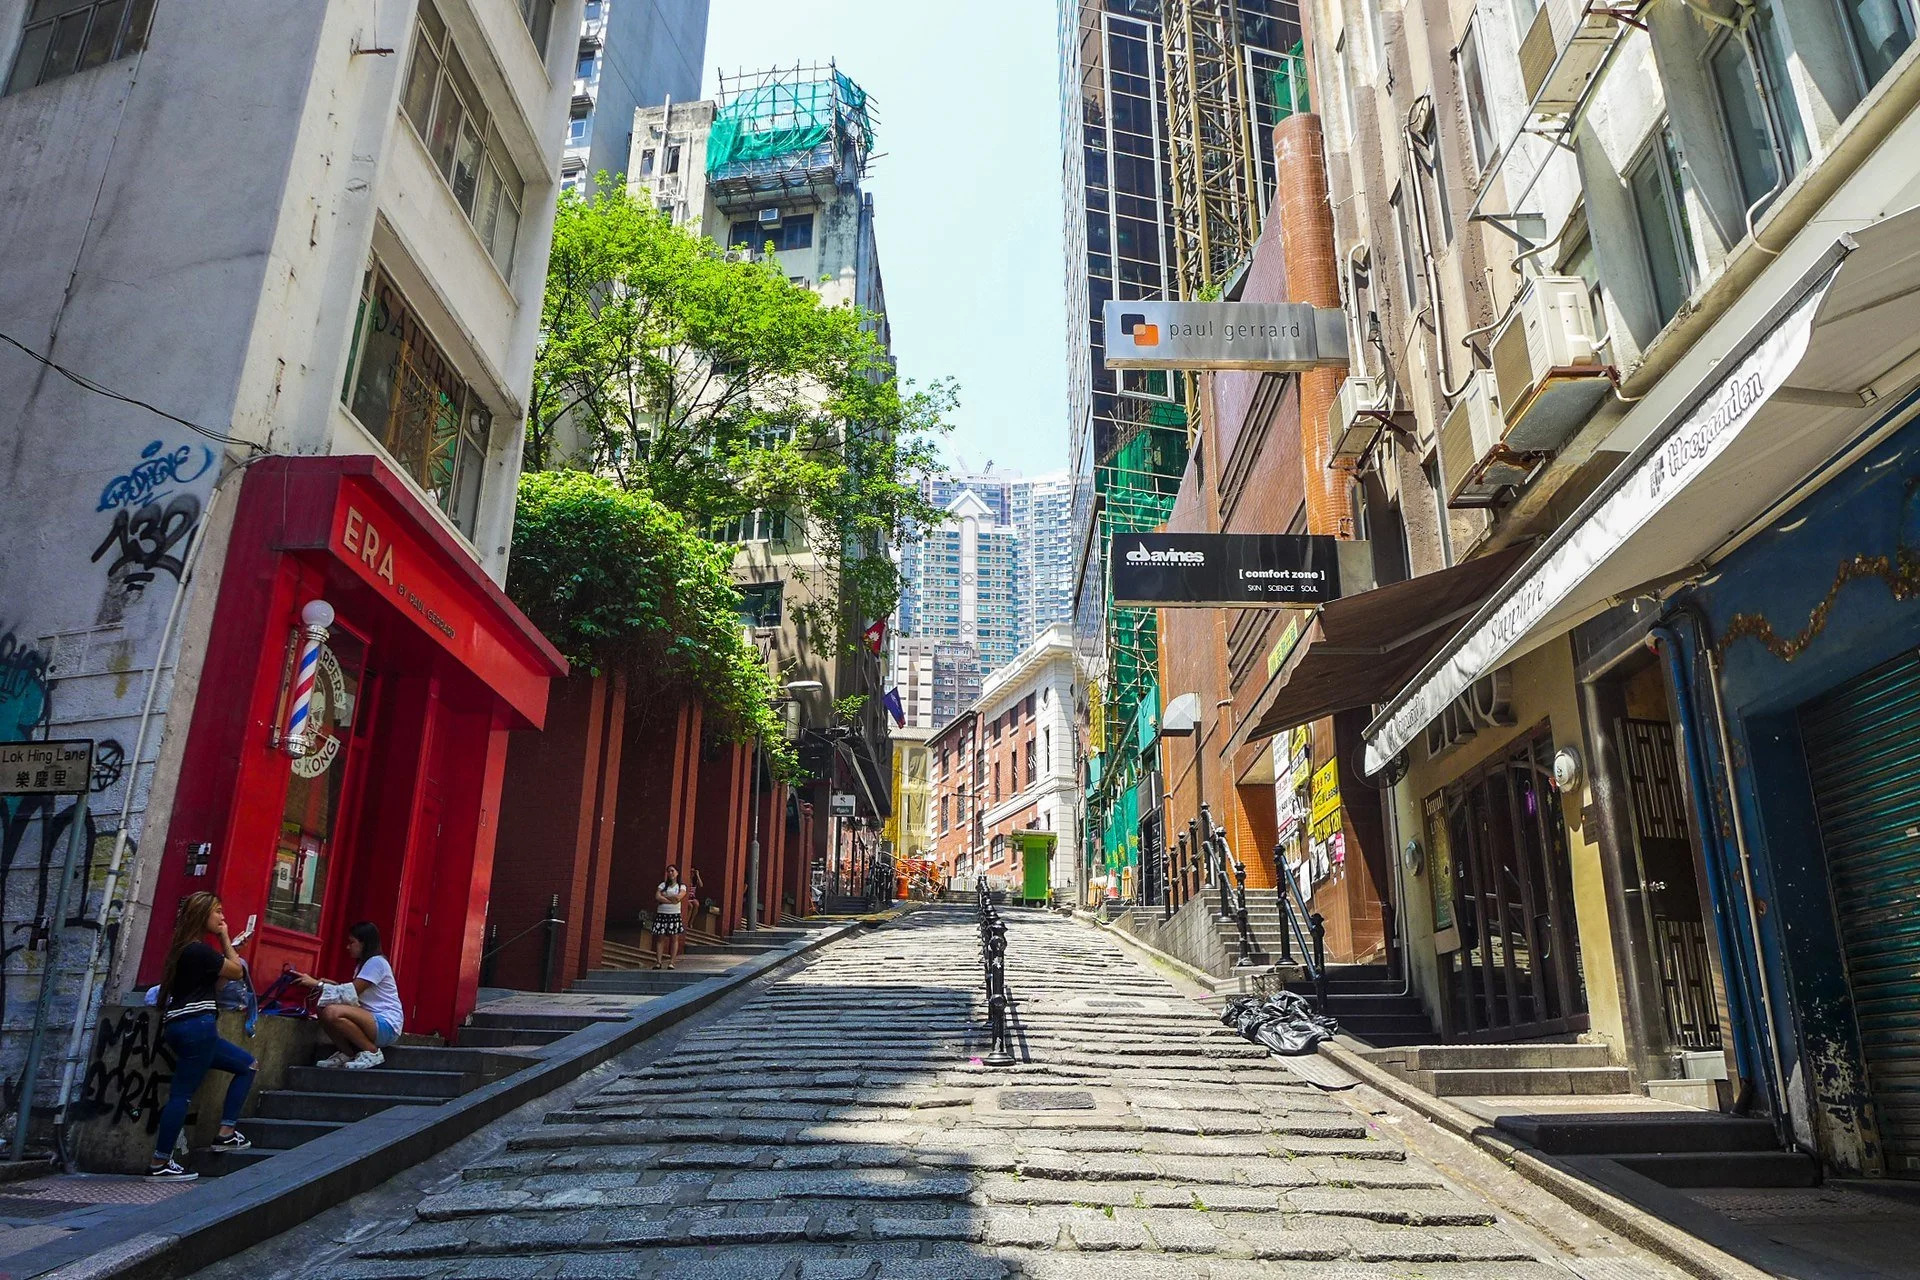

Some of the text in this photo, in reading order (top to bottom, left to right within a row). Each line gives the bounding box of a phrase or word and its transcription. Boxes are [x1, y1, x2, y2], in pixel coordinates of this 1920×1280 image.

[1169, 321, 1300, 341] paul gerrard
[1668, 372, 1764, 477] Hoegaarden
[343, 506, 394, 586] ERA
[1126, 541, 1205, 562] davines
[398, 584, 408, 597] BY
[1247, 584, 1318, 593] SKIN SCIENCE SOUL
[2, 748, 87, 765] Lok Hing Lane
[303, 740, 337, 774] KONG
[15, 770, 67, 789] 樂慶里
